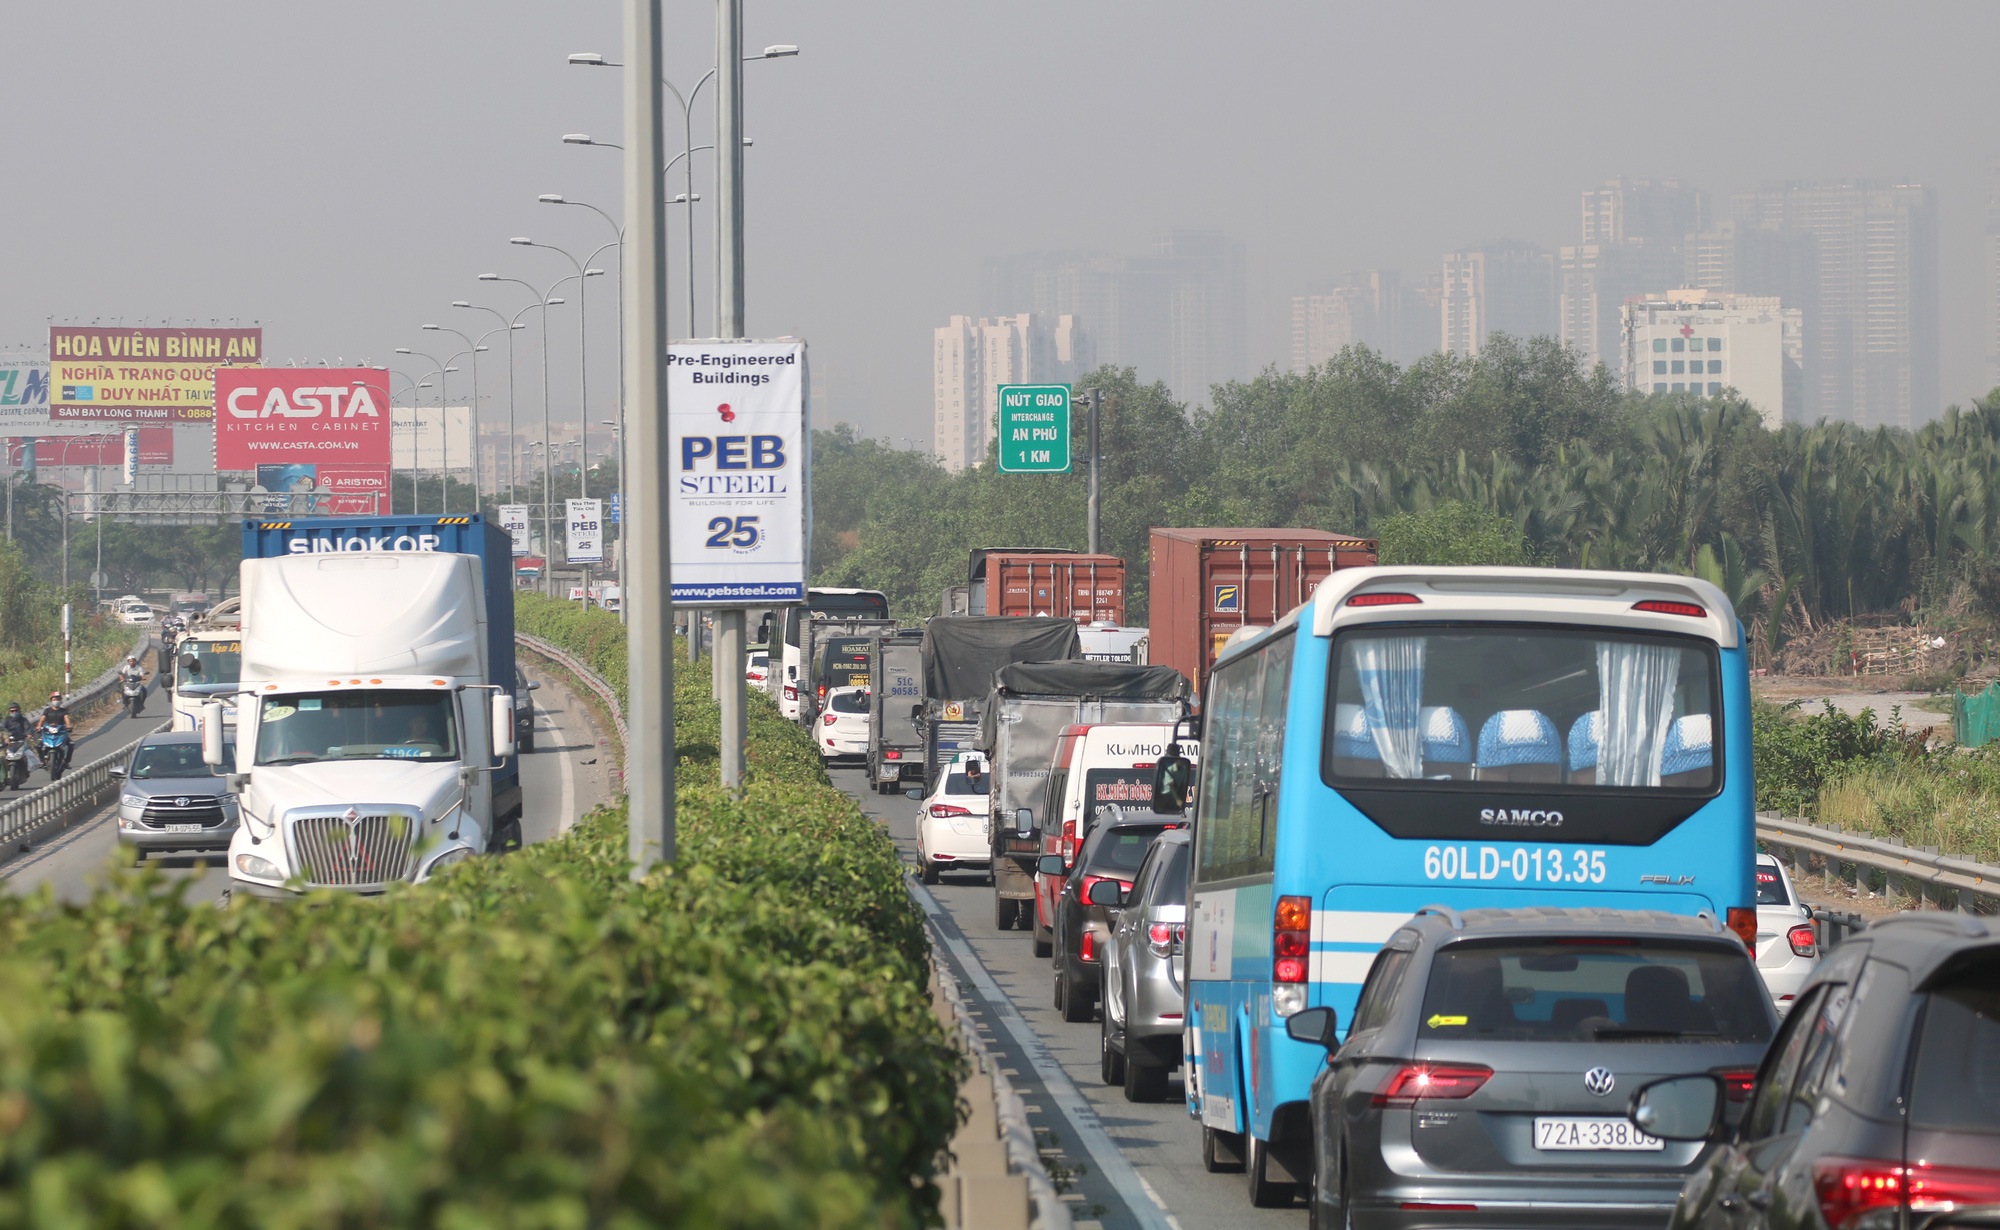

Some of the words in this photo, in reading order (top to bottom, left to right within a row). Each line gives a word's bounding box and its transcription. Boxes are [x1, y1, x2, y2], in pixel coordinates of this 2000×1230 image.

[56, 335, 102, 357] HOA
[107, 332, 160, 357] VIÊN
[166, 332, 221, 358] BÌNH
[226, 336, 256, 358] AN
[667, 353, 795, 368] Pre-Engineered
[61, 365, 114, 381] NGHĨA
[119, 368, 175, 381] TRANG
[180, 364, 213, 381] QUỐ
[693, 372, 770, 386] Buildings
[101, 388, 134, 401] DUY
[137, 383, 181, 401] NHẤT
[227, 387, 379, 418] CASTA
[1006, 391, 1031, 407] NÚT
[1036, 394, 1063, 407] GIAO
[23, 408, 48, 416] CORPOR
[82, 408, 102, 418] BAY
[104, 408, 132, 418] LONG
[1011, 413, 1054, 422] INTERCHANGE
[227, 423, 298, 432] KITCHEN
[312, 422, 380, 431] CABINET
[1012, 428, 1029, 441] AN
[1032, 425, 1057, 441] PHÚ
[248, 441, 359, 450] WWW.CASTA.COM.VN
[681, 435, 788, 472] PEB
[1019, 450, 1025, 463] 1
[1031, 450, 1050, 463] KM
[336, 478, 382, 486] ARISTON
[680, 475, 787, 494] STEEL
[572, 521, 598, 531] PEB
[705, 516, 760, 549] 25
[289, 534, 440, 555] SINOKOR
[578, 541, 591, 549] 25
[670, 585, 797, 598] www.pebsteel.com
[1085, 654, 1110, 662] METTLER
[897, 677, 913, 686] 51C
[891, 687, 919, 696] 90585
[1106, 743, 1162, 756] KUMHO
[1480, 808, 1564, 827] SAMCO
[1424, 846, 1606, 884] 60LD-013.35
[1640, 874, 1696, 886] FELIX
